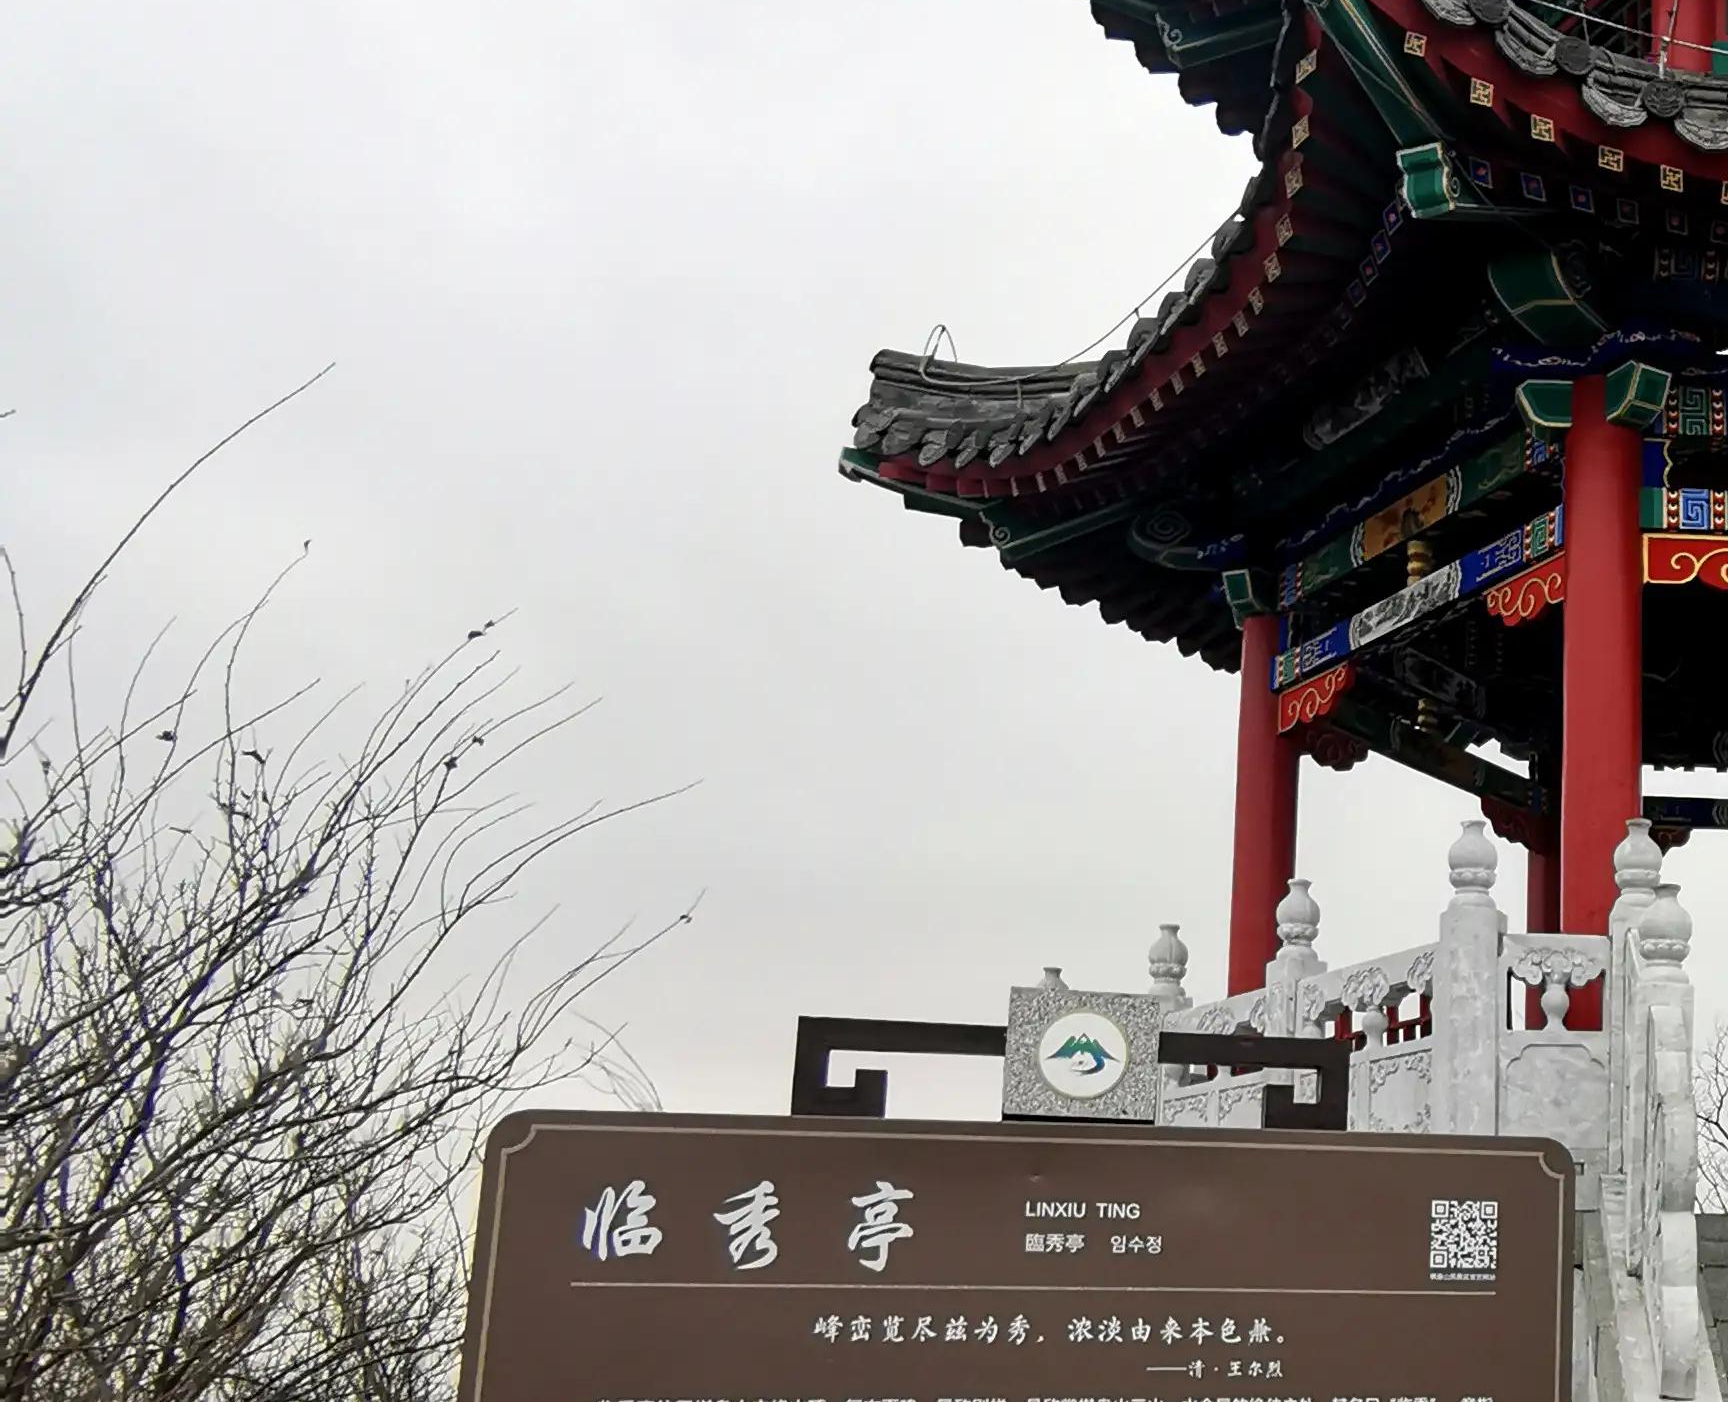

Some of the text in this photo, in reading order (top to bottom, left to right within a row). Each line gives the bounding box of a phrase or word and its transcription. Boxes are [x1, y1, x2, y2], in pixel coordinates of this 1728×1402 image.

[1026, 1201, 1140, 1219] LINXIU TING
[583, 1181, 913, 1271] 临秀亭
[1111, 1236, 1161, 1253] 임수정
